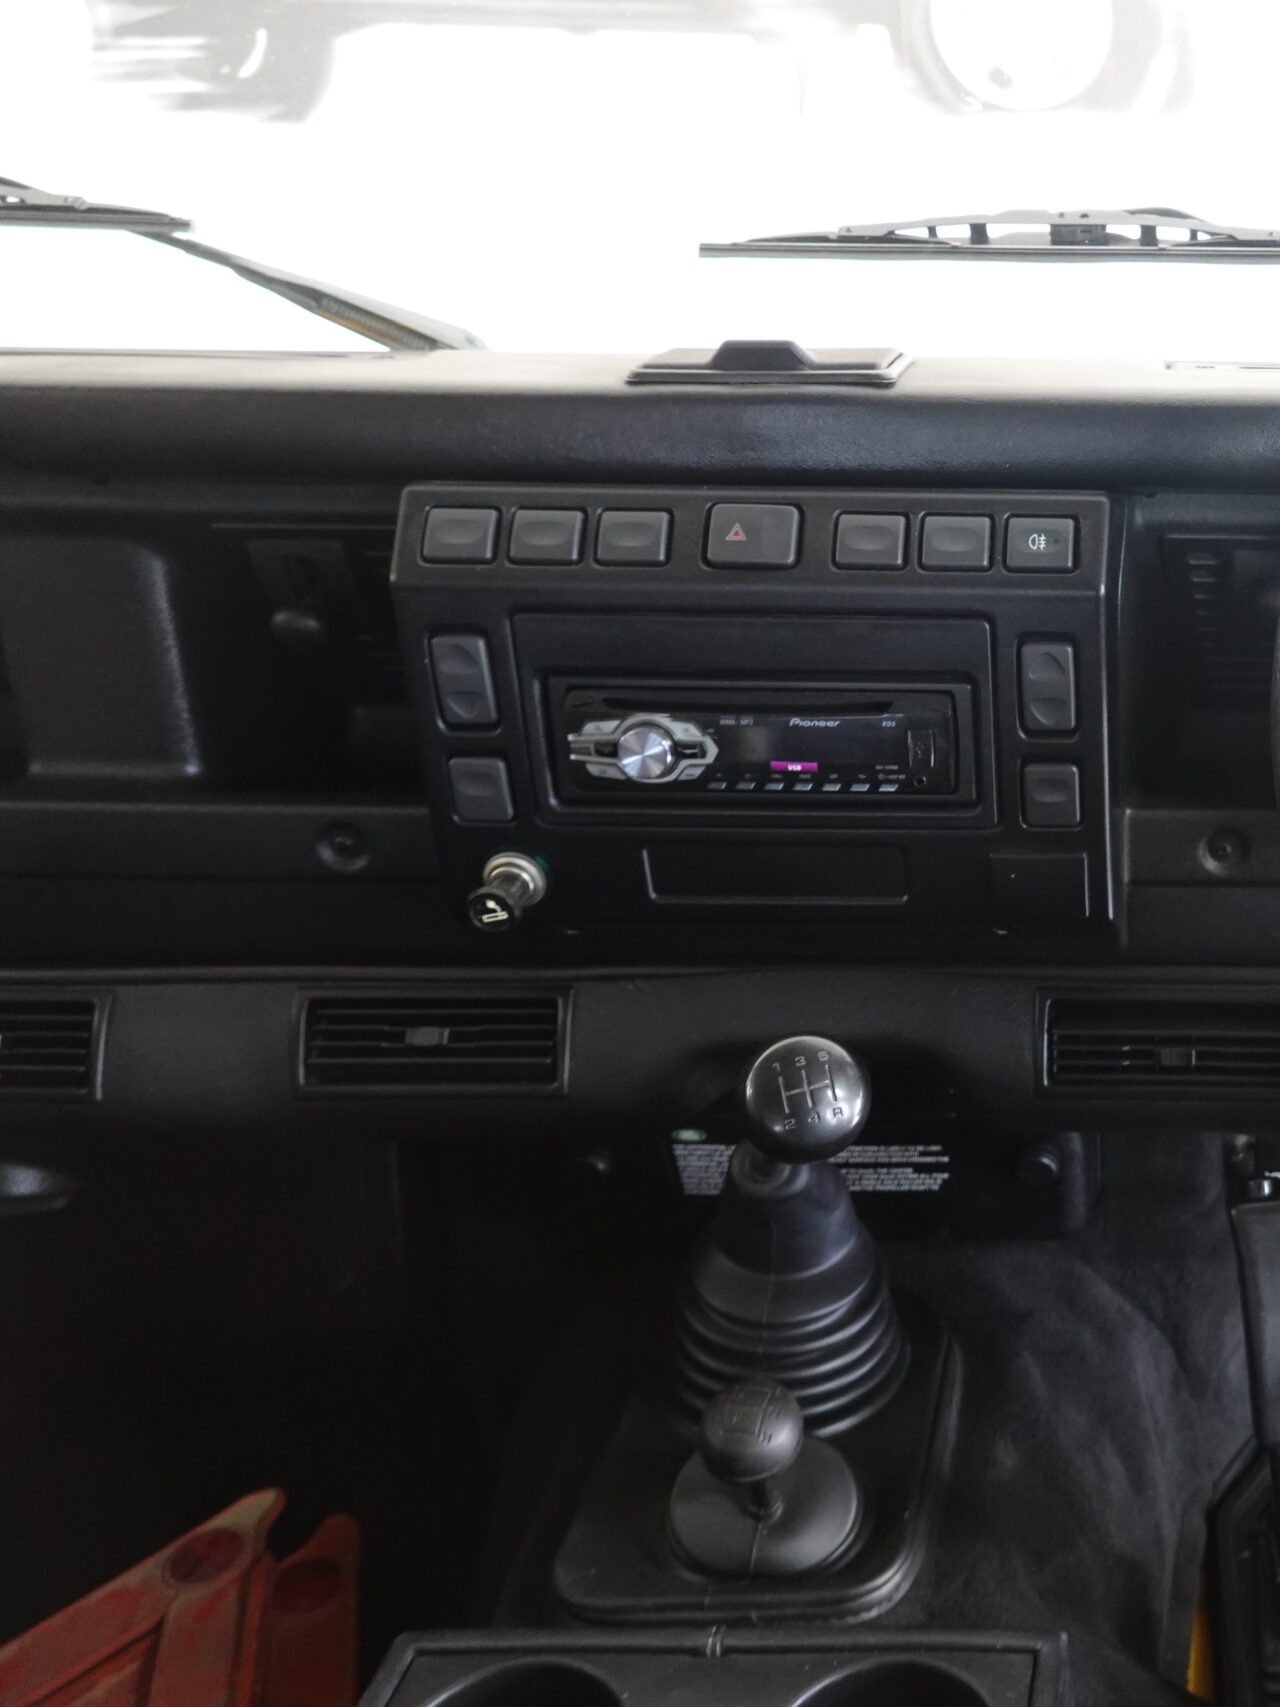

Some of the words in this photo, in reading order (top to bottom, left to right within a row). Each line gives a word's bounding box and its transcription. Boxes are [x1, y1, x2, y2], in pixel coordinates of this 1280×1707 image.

[789, 717, 841, 727] Pioneer
[772, 1062, 782, 1072] 1
[794, 1055, 806, 1066] 3
[784, 1118, 797, 1129] 2
[807, 1110, 820, 1123] 4
